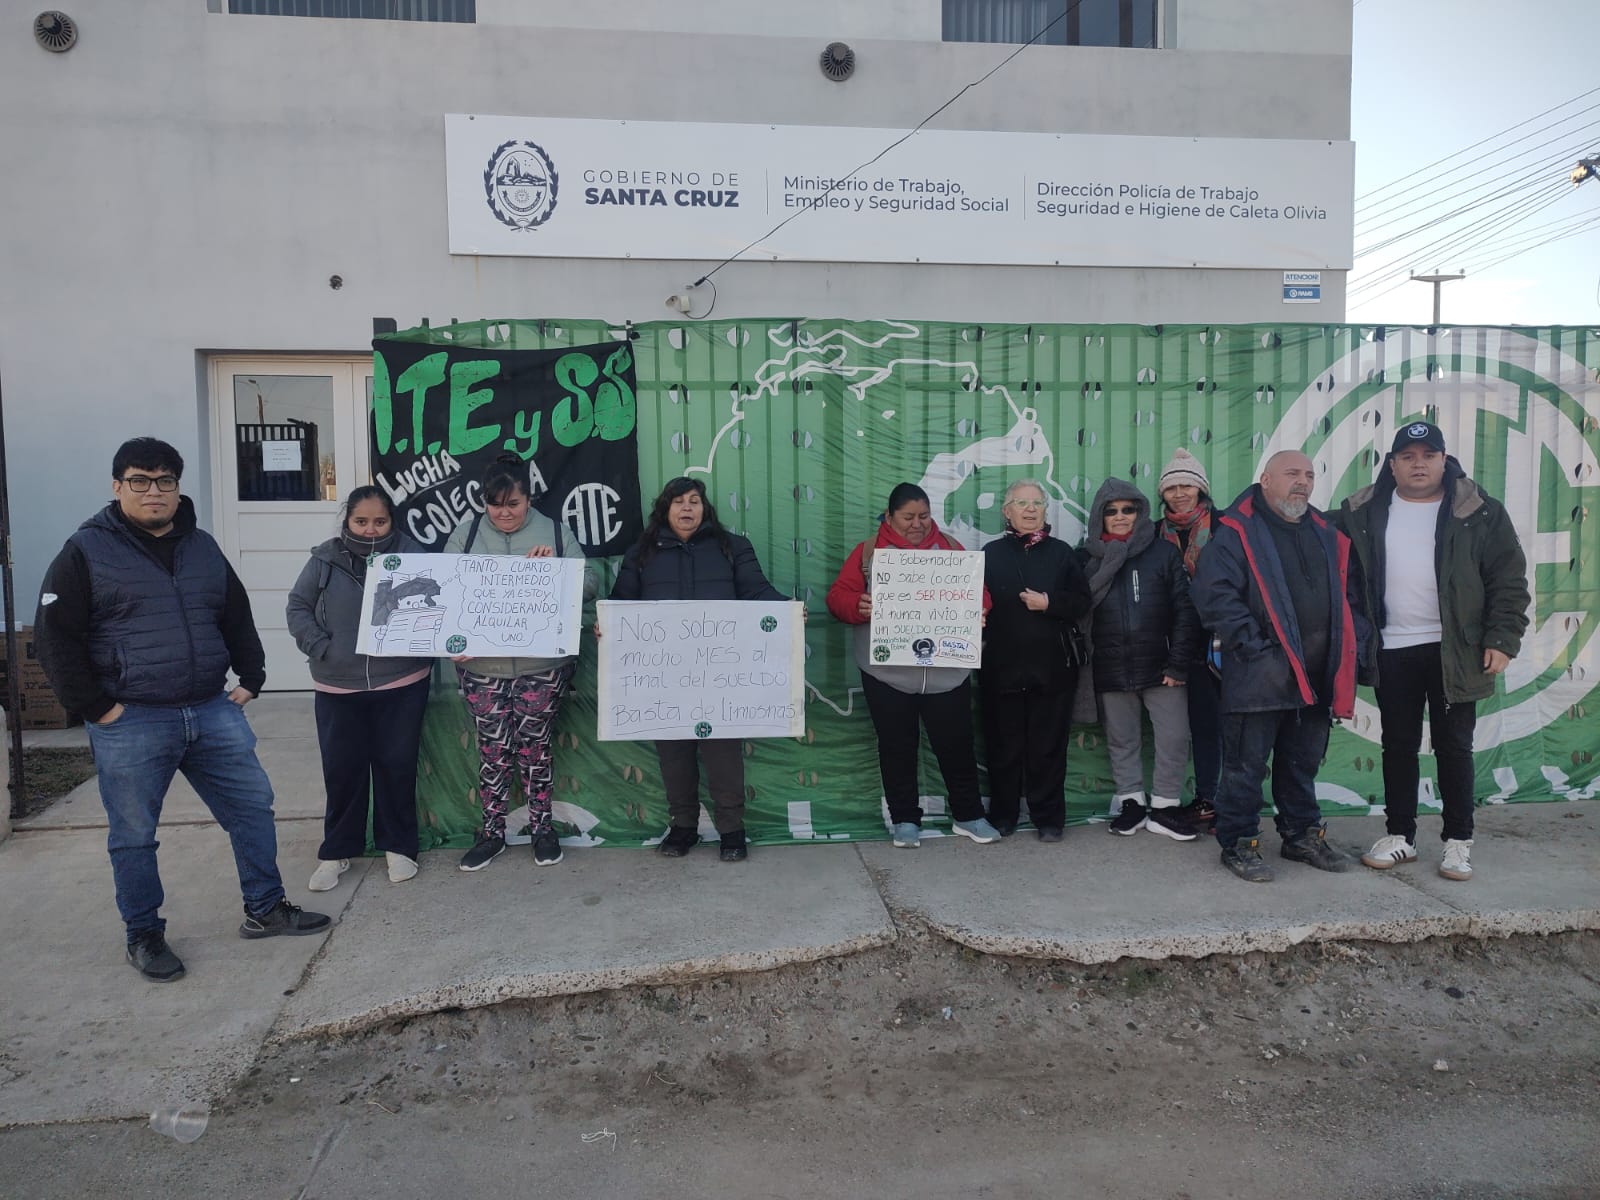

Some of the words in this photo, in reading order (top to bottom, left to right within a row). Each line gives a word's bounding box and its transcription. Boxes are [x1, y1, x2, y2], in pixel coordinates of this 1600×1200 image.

[583, 169, 701, 186] GOBIERNO
[712, 172, 739, 187] DE
[784, 175, 869, 192] Ministerio
[873, 177, 895, 192] de
[899, 178, 965, 197] Trabajo,
[584, 187, 668, 207] SANTA
[674, 189, 740, 208] CRUZ
[784, 192, 850, 211] Empleo
[853, 196, 864, 212] y
[869, 194, 956, 213] Seguridad
[960, 197, 1009, 212] Social
[1037, 181, 1114, 197] Dirección
[1120, 184, 1171, 199] Policía
[1175, 185, 1196, 199] de
[1200, 186, 1260, 204] Trabajo
[1037, 200, 1120, 217] Seguridad
[1124, 204, 1135, 215] e
[1139, 201, 1201, 219] Higiene
[1205, 204, 1225, 218] de
[1229, 205, 1279, 219] Caleta
[1283, 206, 1327, 220] Olivia
[376, 449, 462, 506] LUCHA
[562, 483, 623, 546] ATE
[462, 558, 499, 573] TANTO
[511, 560, 552, 573] CUARTO
[481, 573, 551, 587] INTERMEDIO
[876, 572, 891, 585] NO
[473, 588, 497, 600] QUE
[518, 588, 552, 602] ESTOY
[876, 591, 896, 609] que
[915, 589, 936, 602] SER
[467, 600, 558, 614] CONSIDERANDO
[473, 614, 528, 630] ALQUILAR
[617, 613, 666, 643] Nos
[679, 610, 737, 640] sobra
[620, 648, 682, 667] mucho
[695, 646, 741, 666] MES
[752, 640, 768, 664] al
[680, 669, 706, 688] del
[713, 672, 788, 688] SUELDO
[612, 699, 681, 726] Basta
[690, 697, 716, 720] de
